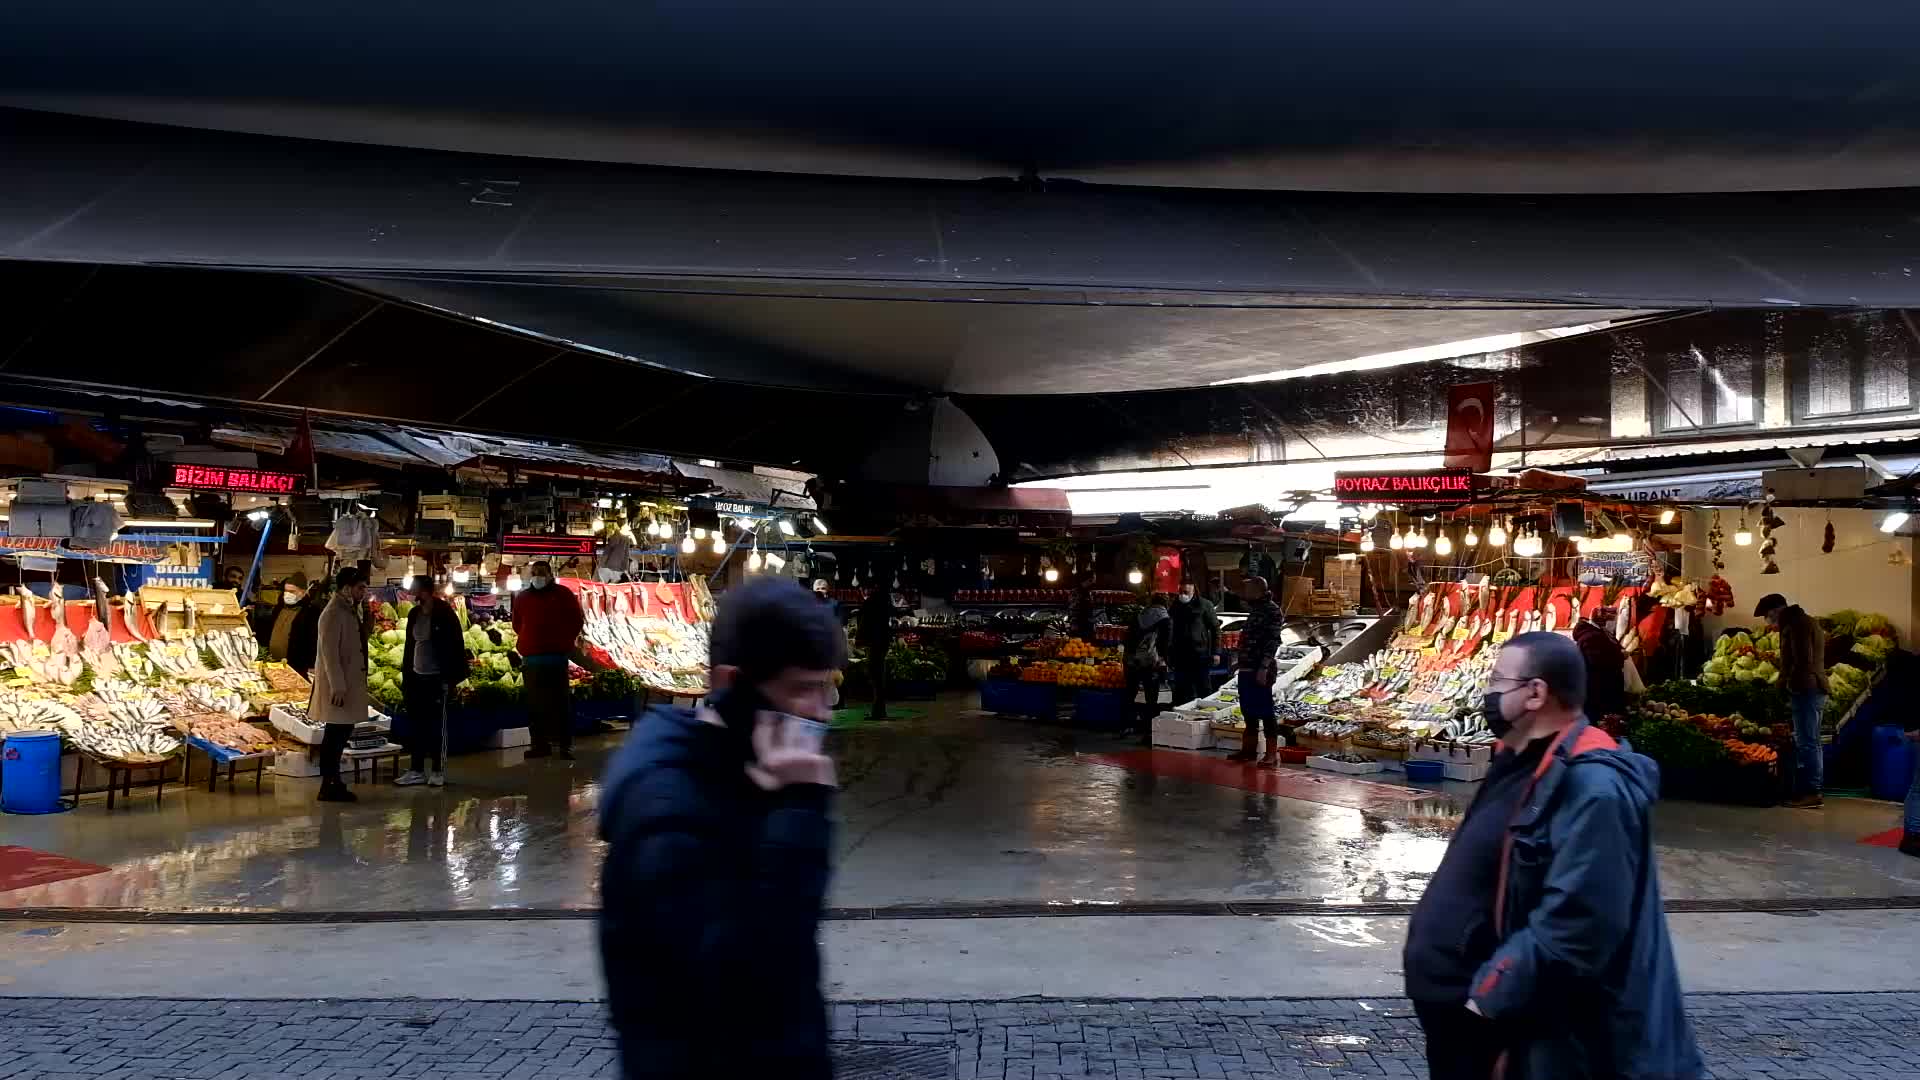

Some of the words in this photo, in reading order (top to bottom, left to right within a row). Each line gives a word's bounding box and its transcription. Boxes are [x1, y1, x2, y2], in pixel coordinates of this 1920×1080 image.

[228, 473, 294, 491] BALIKÇI
[1336, 477, 1390, 491] POYRAZ
[1392, 476, 1468, 493] BALIKÇILIK
